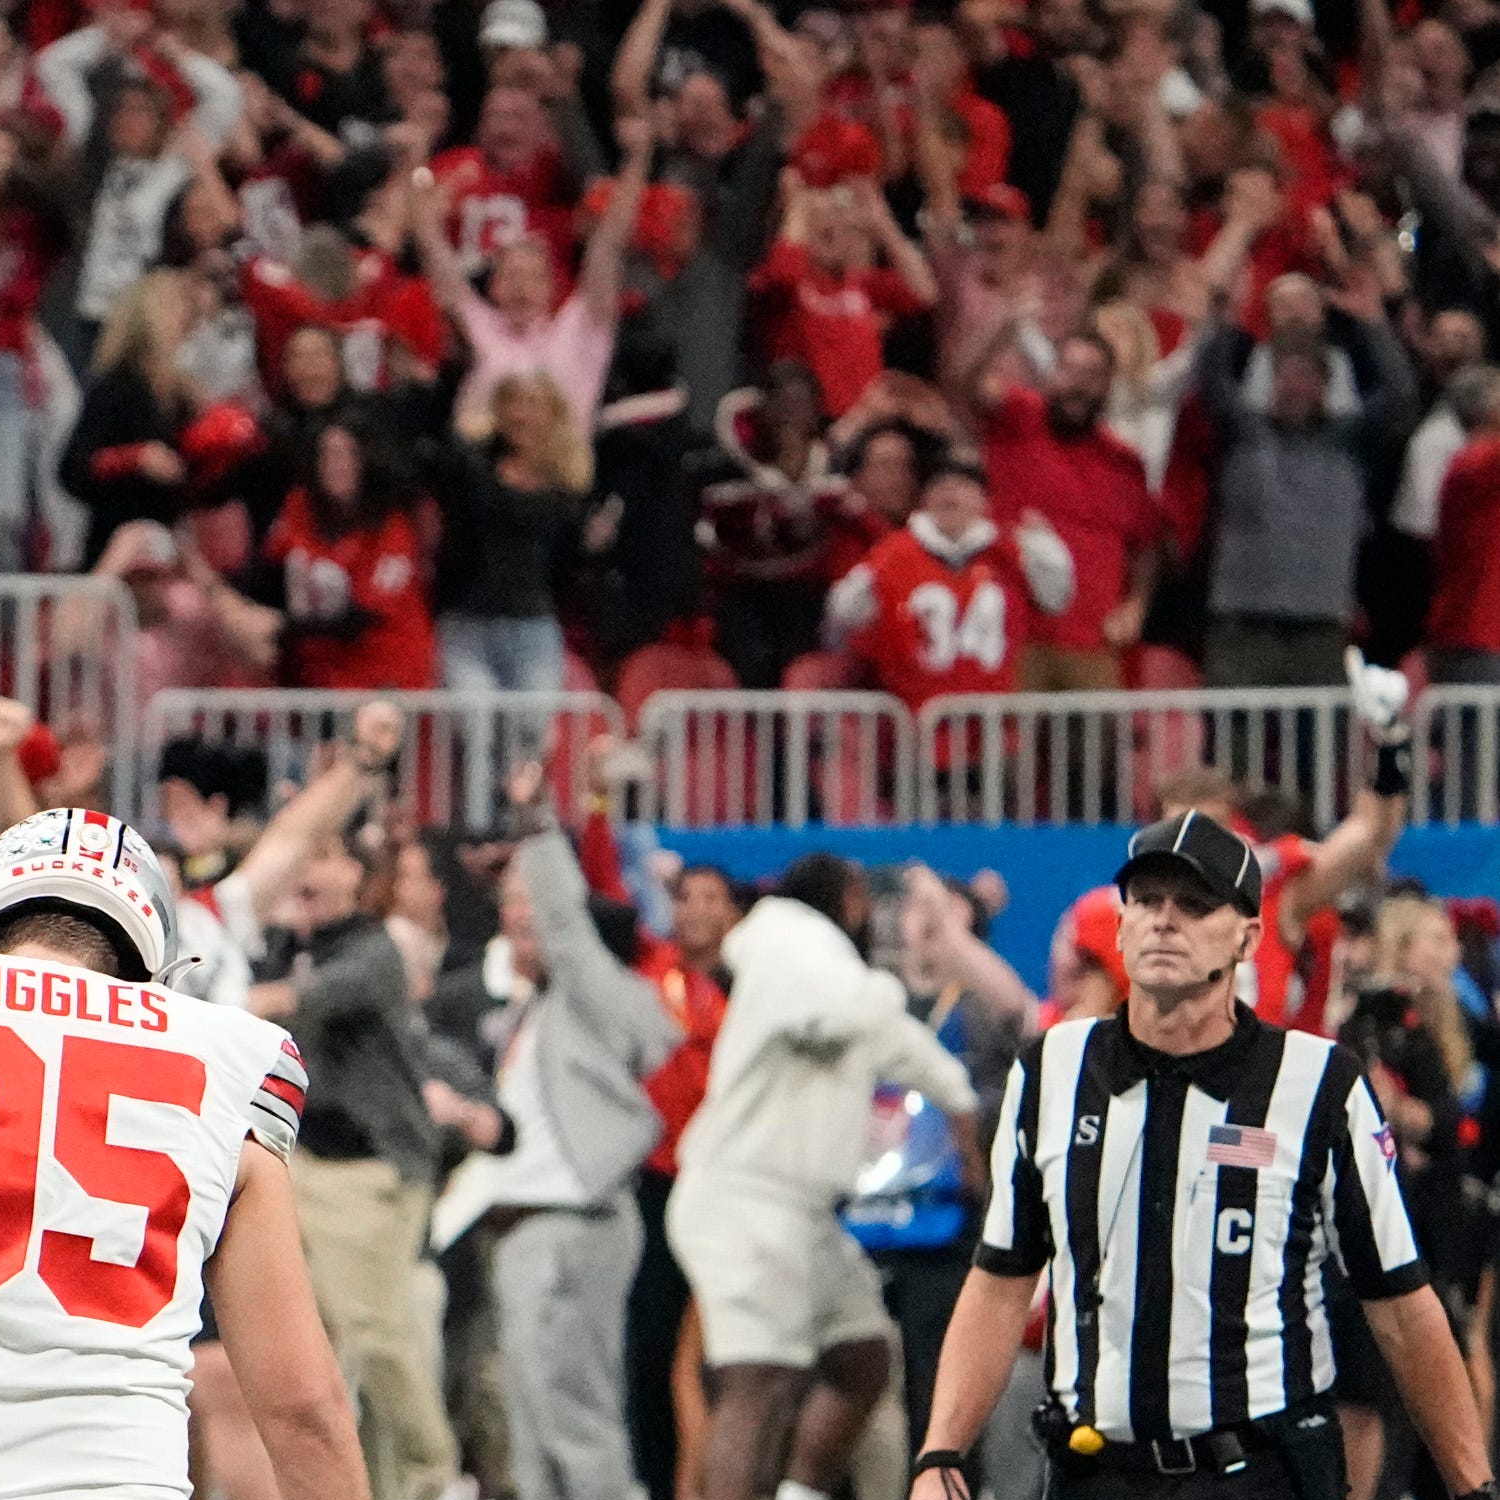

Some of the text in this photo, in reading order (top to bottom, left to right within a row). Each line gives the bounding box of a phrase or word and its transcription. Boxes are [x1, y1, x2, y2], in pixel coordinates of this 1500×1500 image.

[908, 581, 1006, 674] 34
[11, 859, 153, 918] BUCKEYES
[1074, 1114, 1100, 1146] S
[1215, 1207, 1254, 1256] C
